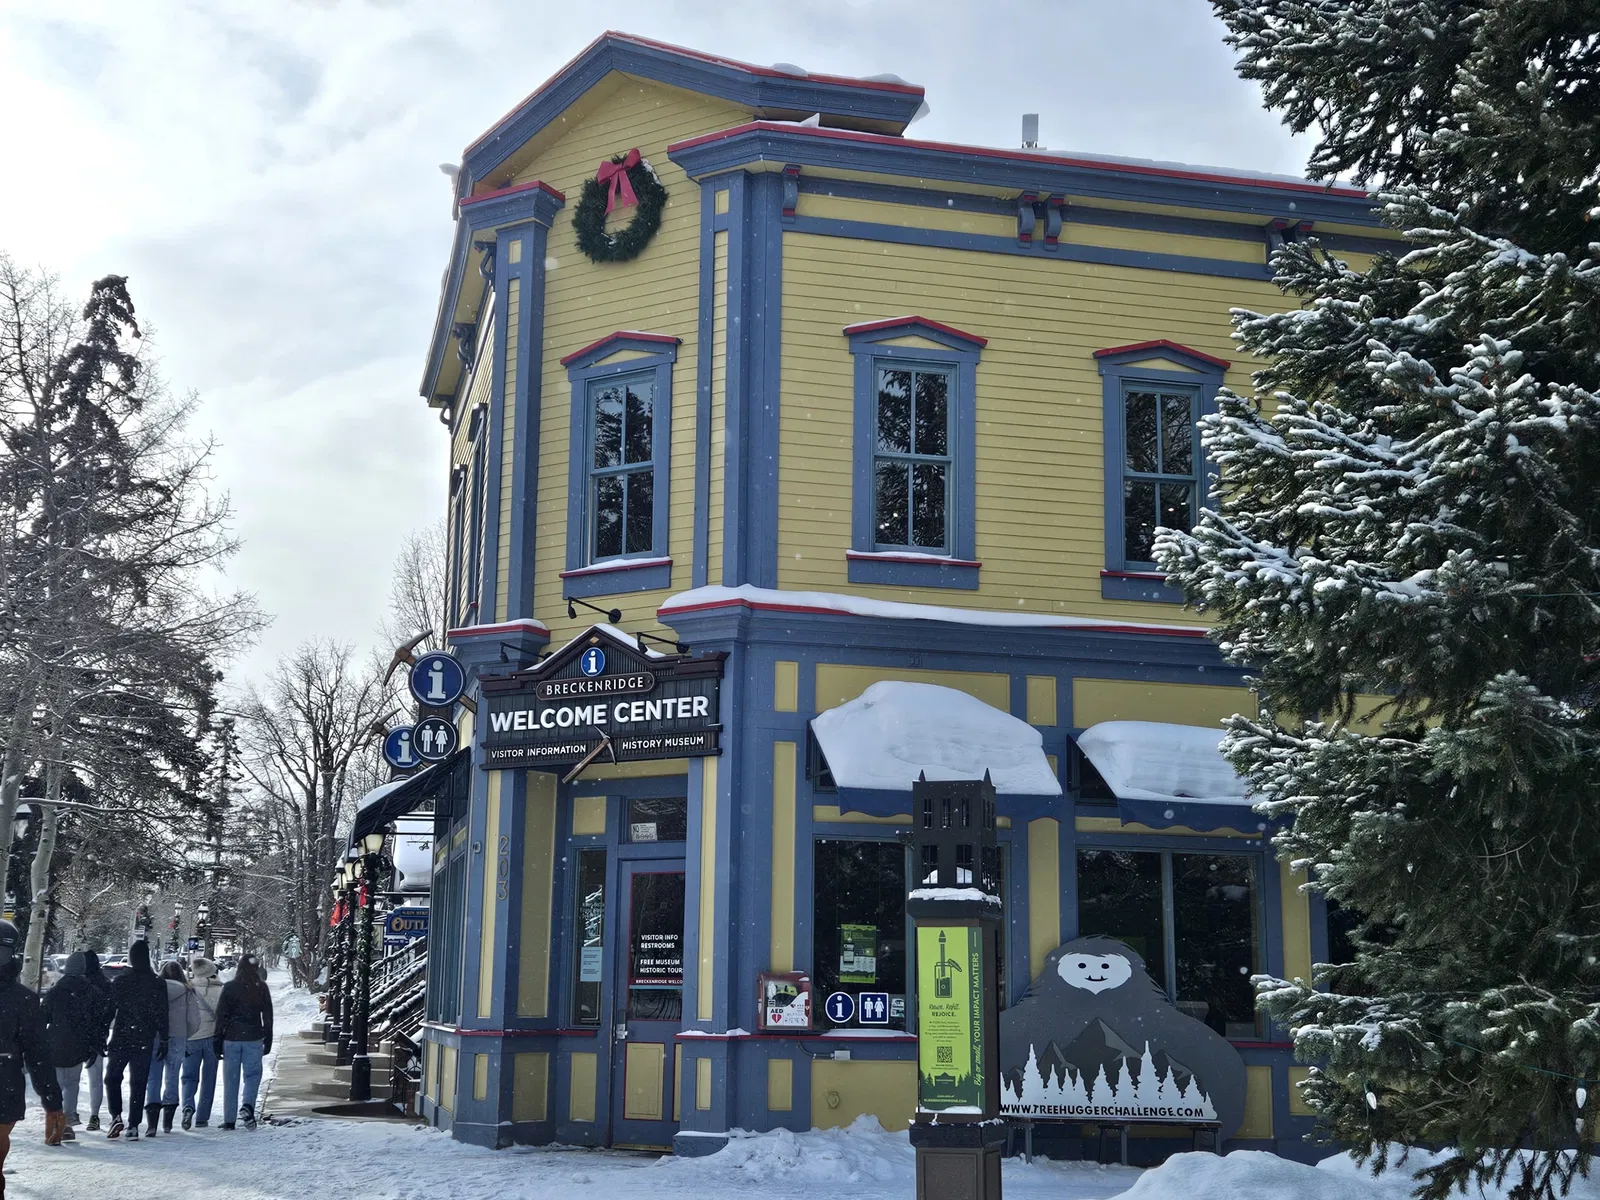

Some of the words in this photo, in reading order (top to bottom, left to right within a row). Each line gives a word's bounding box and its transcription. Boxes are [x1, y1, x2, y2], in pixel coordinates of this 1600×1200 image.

[546, 677, 644, 695] BRECKENRIDGE
[490, 704, 607, 732] WELCOME
[614, 696, 709, 723] CENTER
[491, 749, 524, 759] VISITOR
[527, 744, 587, 757] INFORMATION
[622, 739, 662, 750] HISTORY
[665, 736, 704, 747] MUSEUM
[497, 835, 509, 900] 203
[972, 990, 980, 1019] IMPACT
[973, 1020, 981, 1042] YOUR
[973, 1073, 985, 1086] Big
[1000, 1104, 1204, 1117] WWW.TREEHUGGERCHALLENGE.COM
